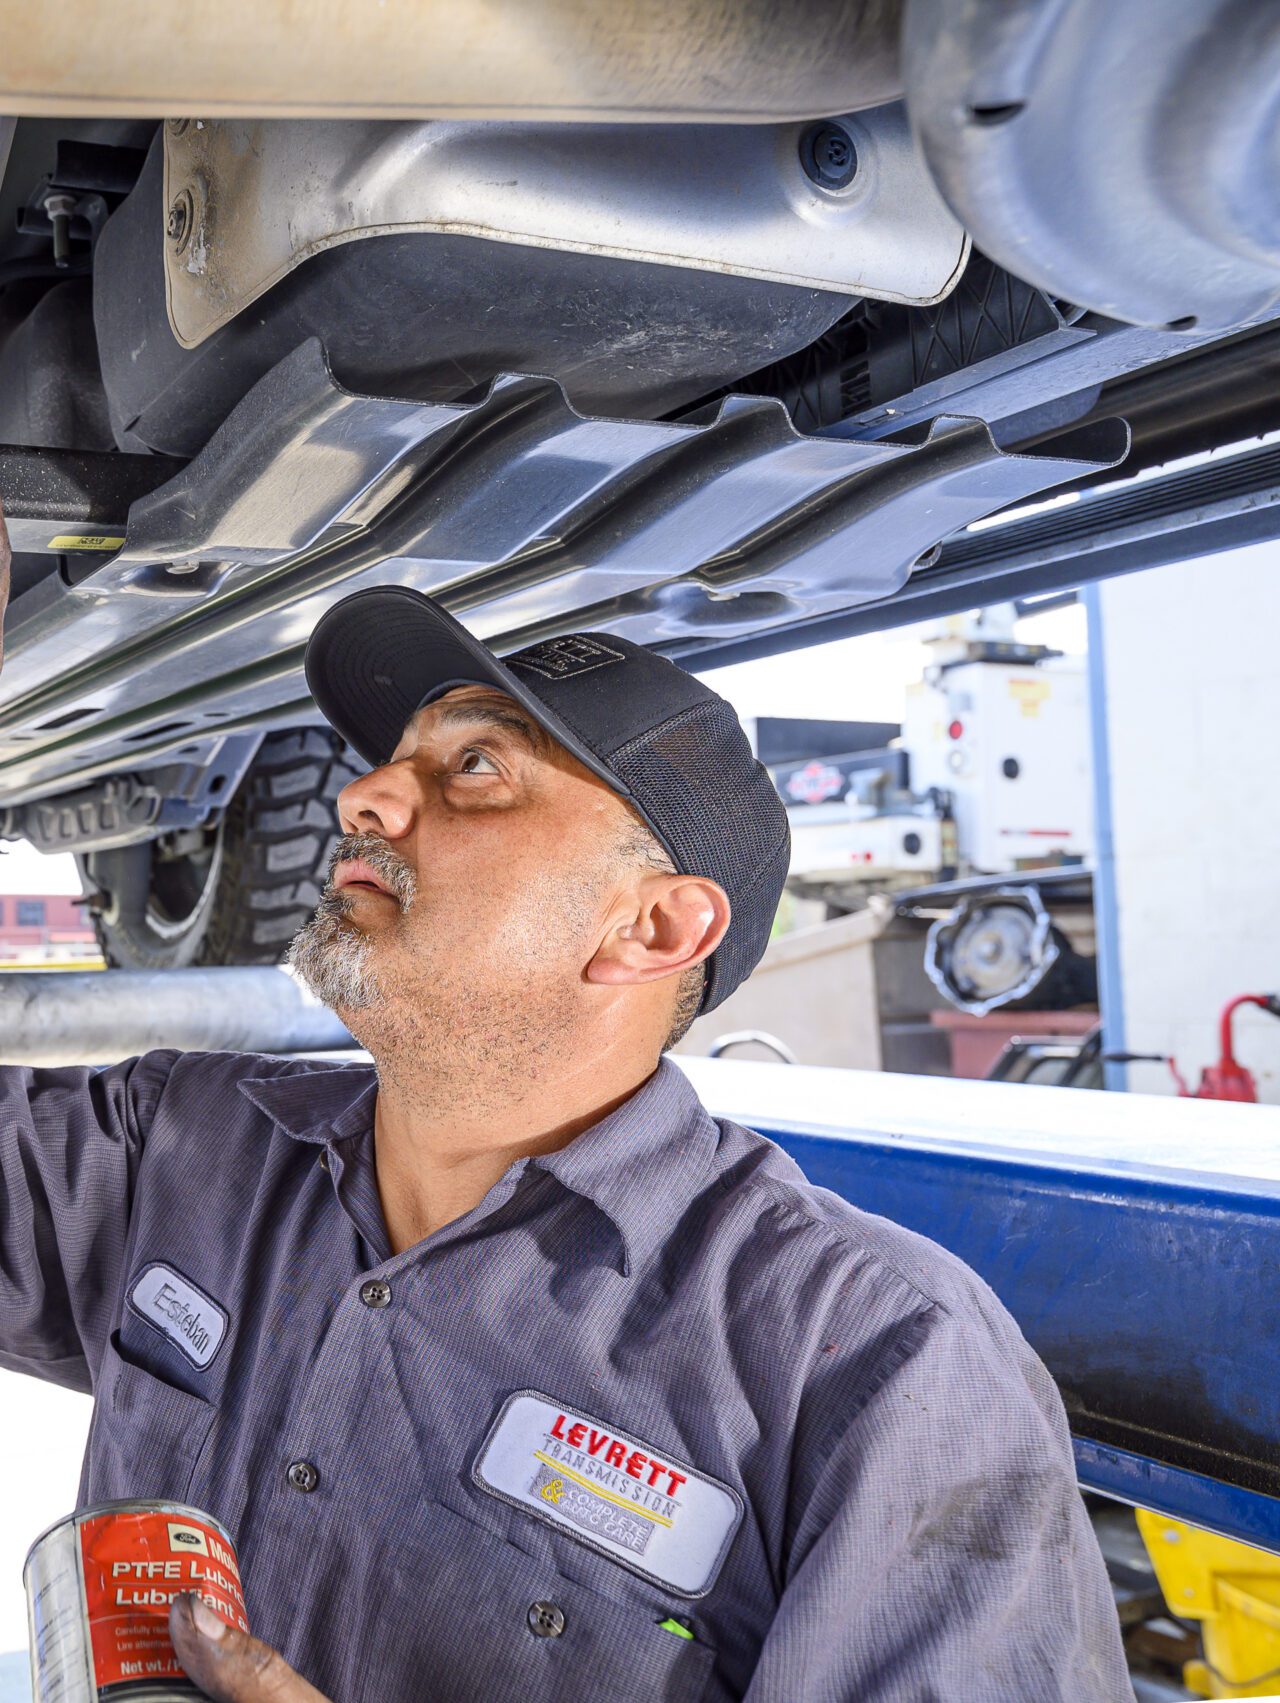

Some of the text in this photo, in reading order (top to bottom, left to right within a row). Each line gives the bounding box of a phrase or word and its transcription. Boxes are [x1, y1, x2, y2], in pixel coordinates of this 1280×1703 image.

[153, 1282, 210, 1355] Esteban
[550, 1414, 687, 1498] LEVRETT
[540, 1478, 566, 1504] &
[542, 1438, 678, 1519] TRANSMISSION
[569, 1489, 649, 1539] COMPLETE
[604, 1522, 644, 1549] CARE
[112, 1560, 182, 1579] PTFE
[121, 1660, 143, 1676] Net
